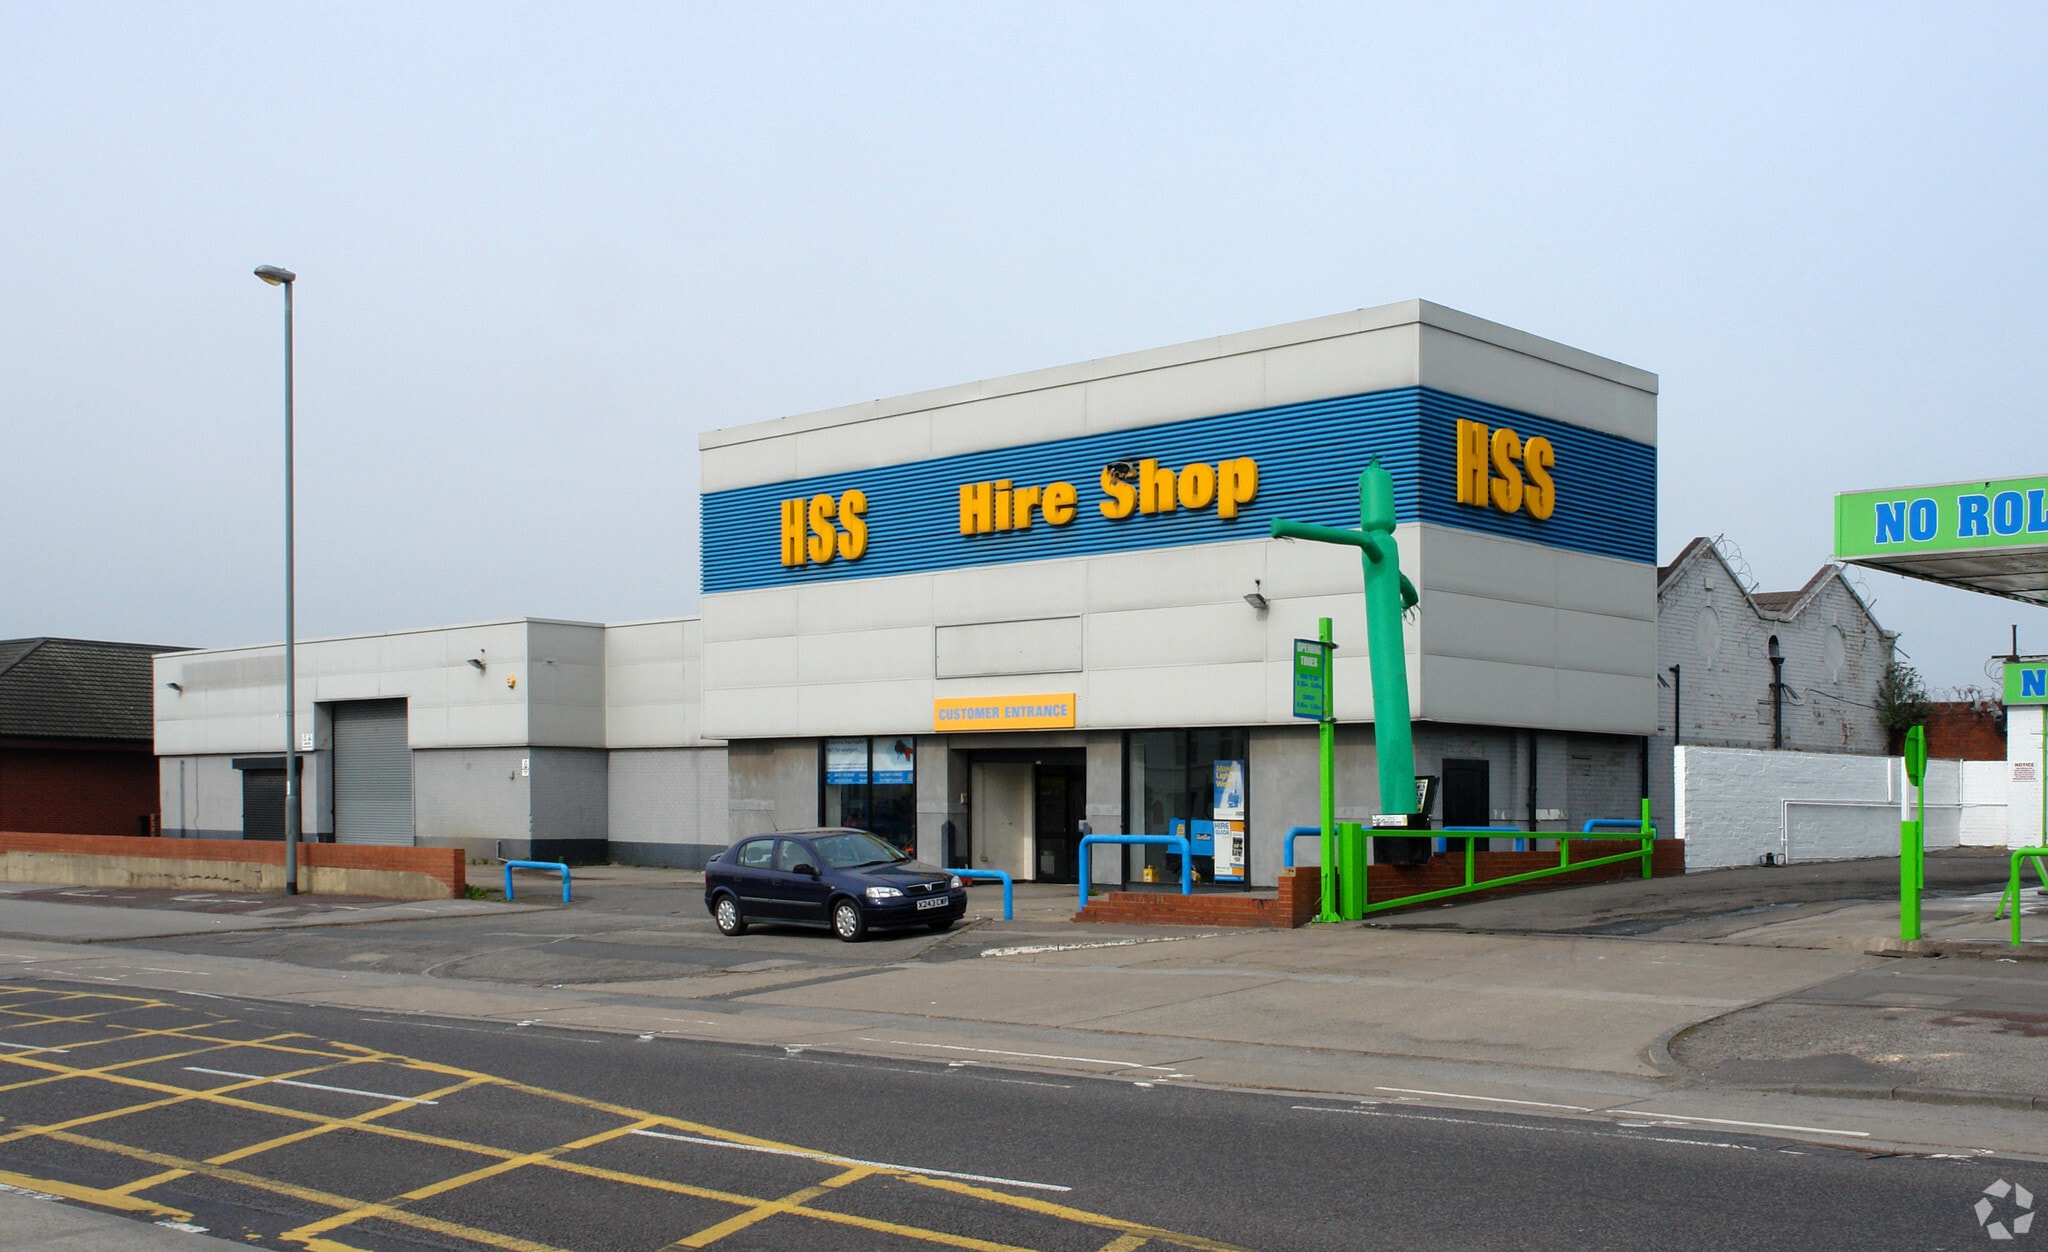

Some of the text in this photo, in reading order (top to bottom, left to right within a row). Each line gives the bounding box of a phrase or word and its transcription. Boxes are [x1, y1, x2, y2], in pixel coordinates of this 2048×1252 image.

[1456, 418, 1556, 520] HSS
[780, 456, 1259, 567] HSS Hire Shop
[1874, 488, 2048, 545] NO ROL
[938, 703, 1069, 721] CUSTOMER ENTRANCE
[1214, 822, 1230, 830] HIRE
